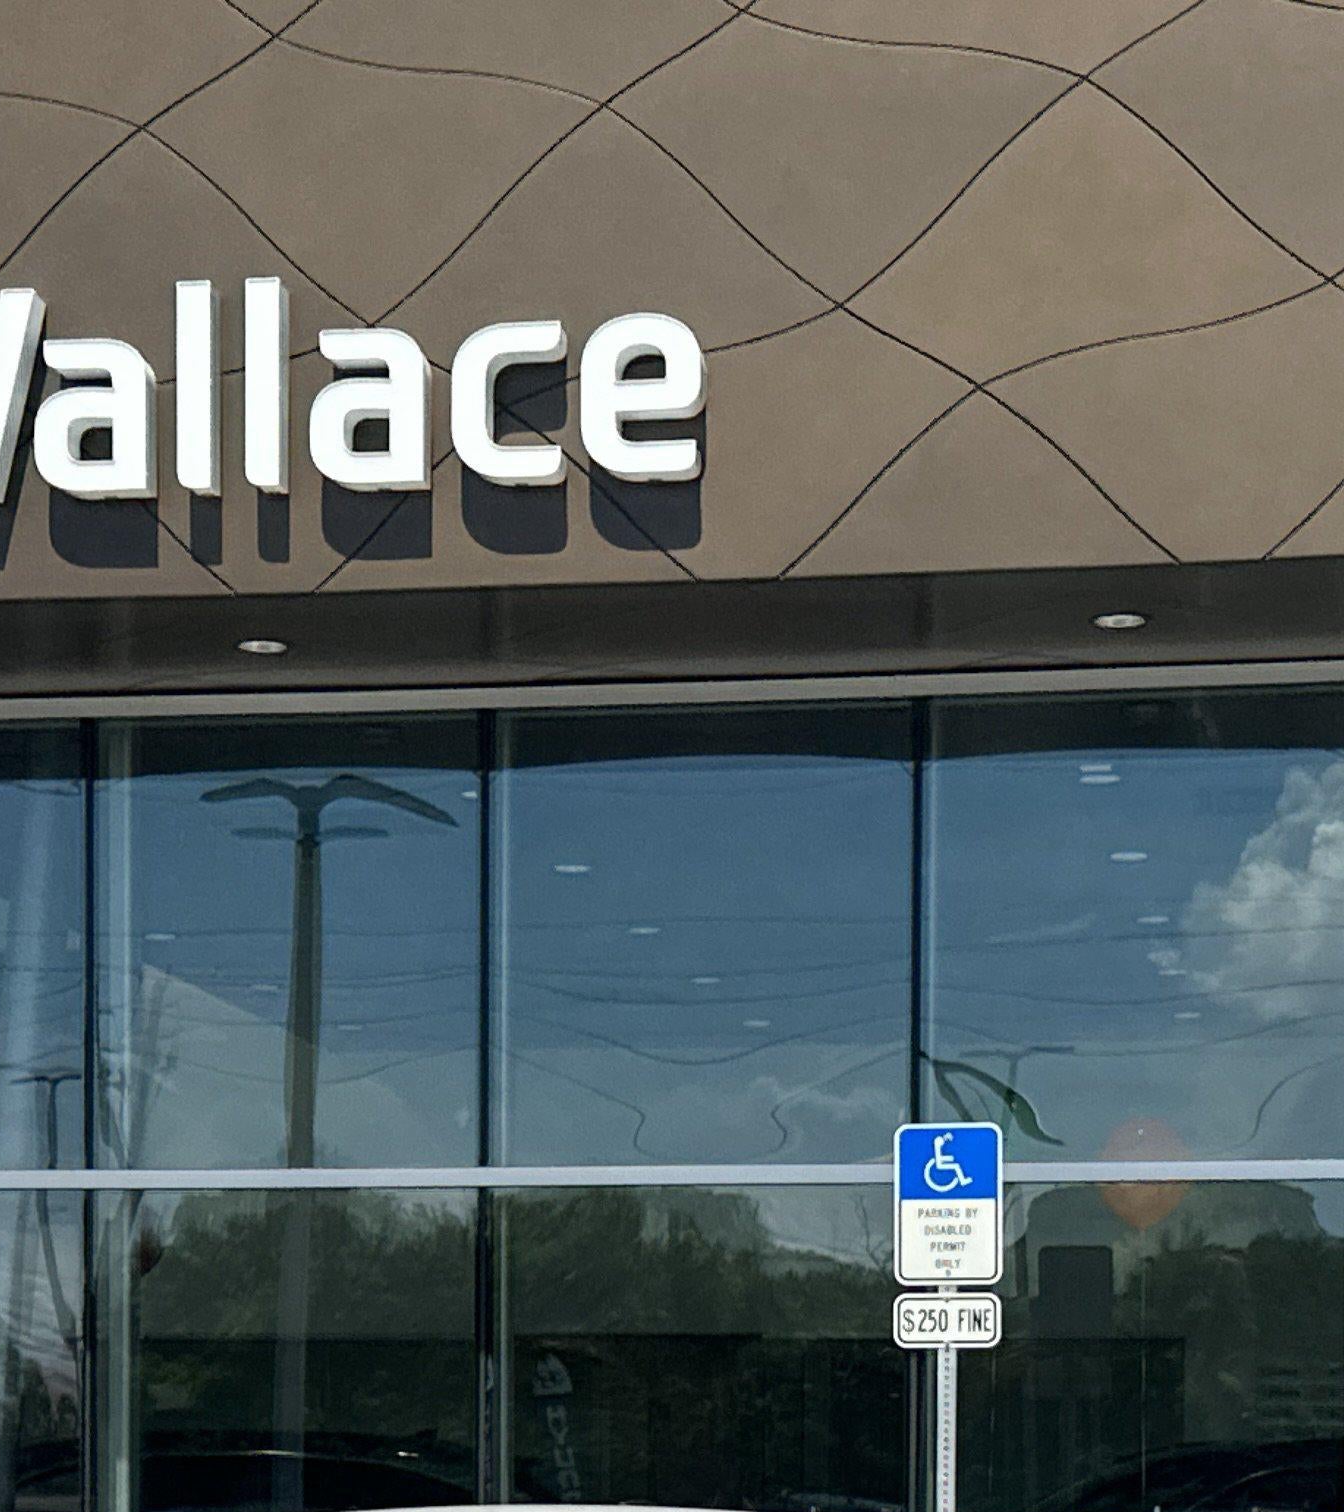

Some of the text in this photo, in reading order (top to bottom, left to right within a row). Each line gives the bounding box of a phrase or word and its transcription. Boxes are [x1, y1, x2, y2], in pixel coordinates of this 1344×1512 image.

[917, 1207, 978, 1218] PARKING BY
[924, 1225, 972, 1235] DISABLED
[929, 1241, 966, 1252] PERMIT
[902, 1308, 993, 1335] $250 FINE
